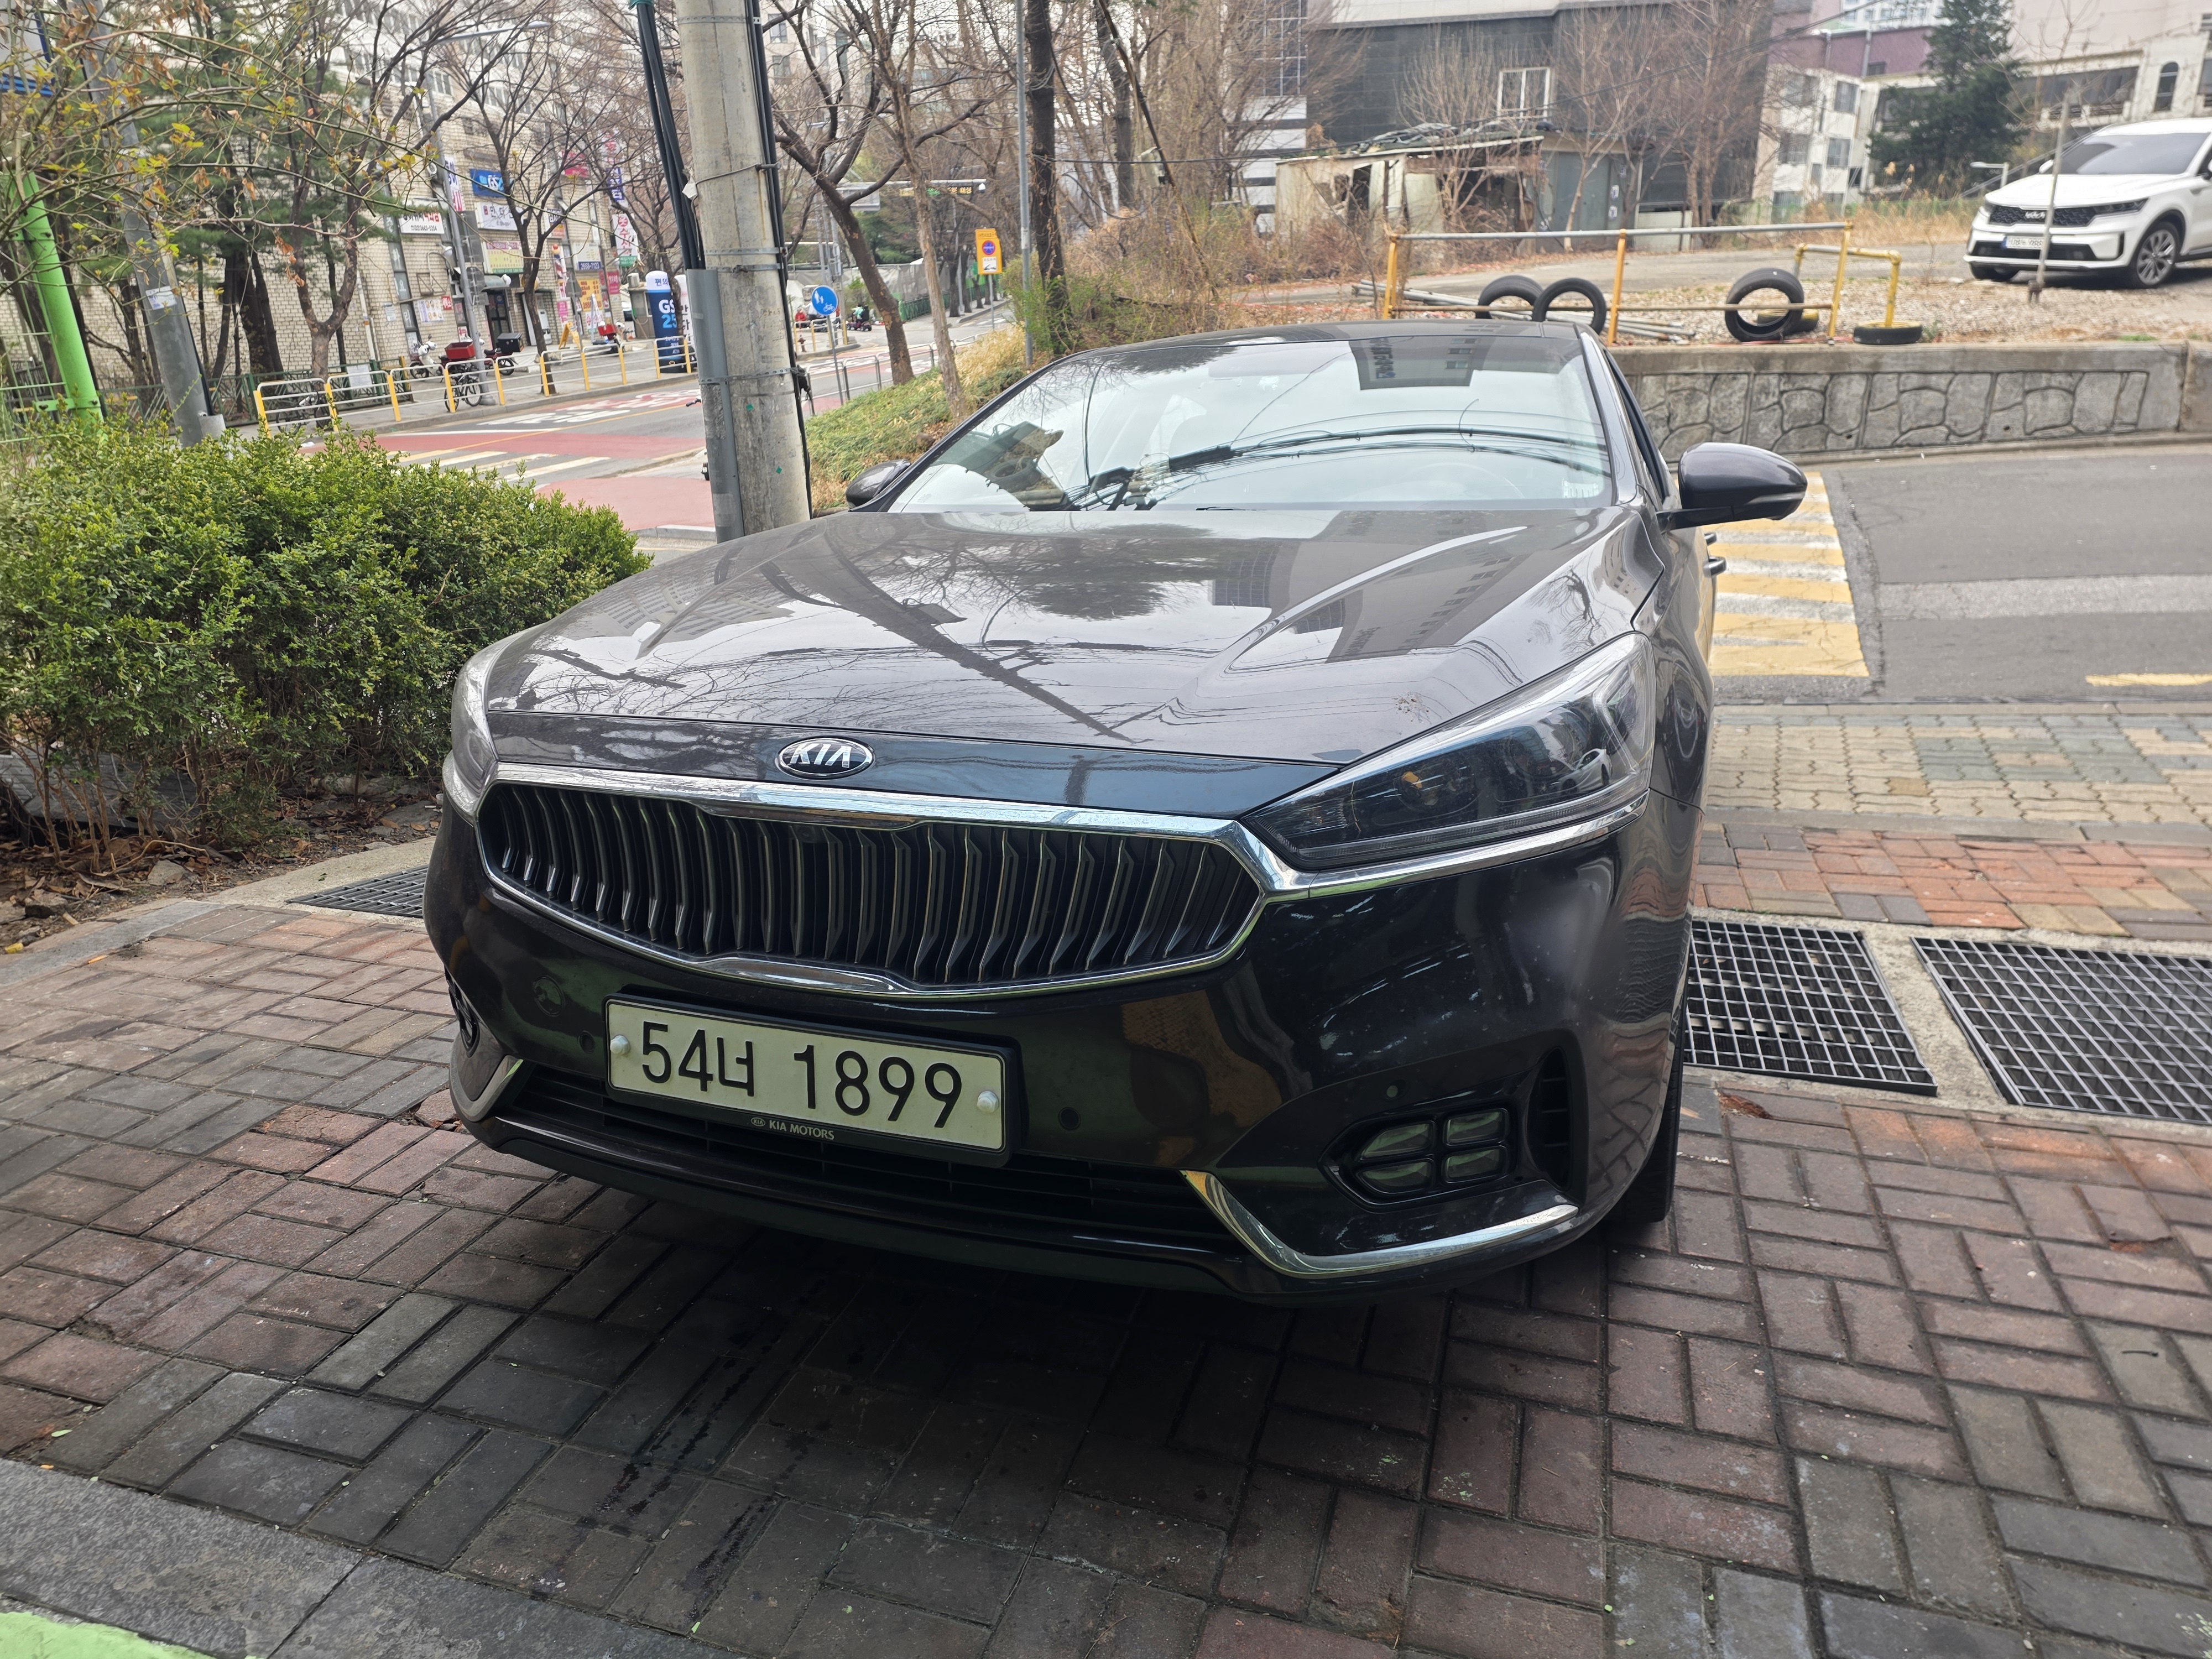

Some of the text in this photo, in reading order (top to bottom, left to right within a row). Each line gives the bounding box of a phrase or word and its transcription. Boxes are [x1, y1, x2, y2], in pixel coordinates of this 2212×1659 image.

[789, 743, 852, 769] KIA
[641, 1021, 963, 1129] 54너 1899
[769, 1120, 787, 1131] KIA
[790, 1124, 834, 1140] MOTORS
